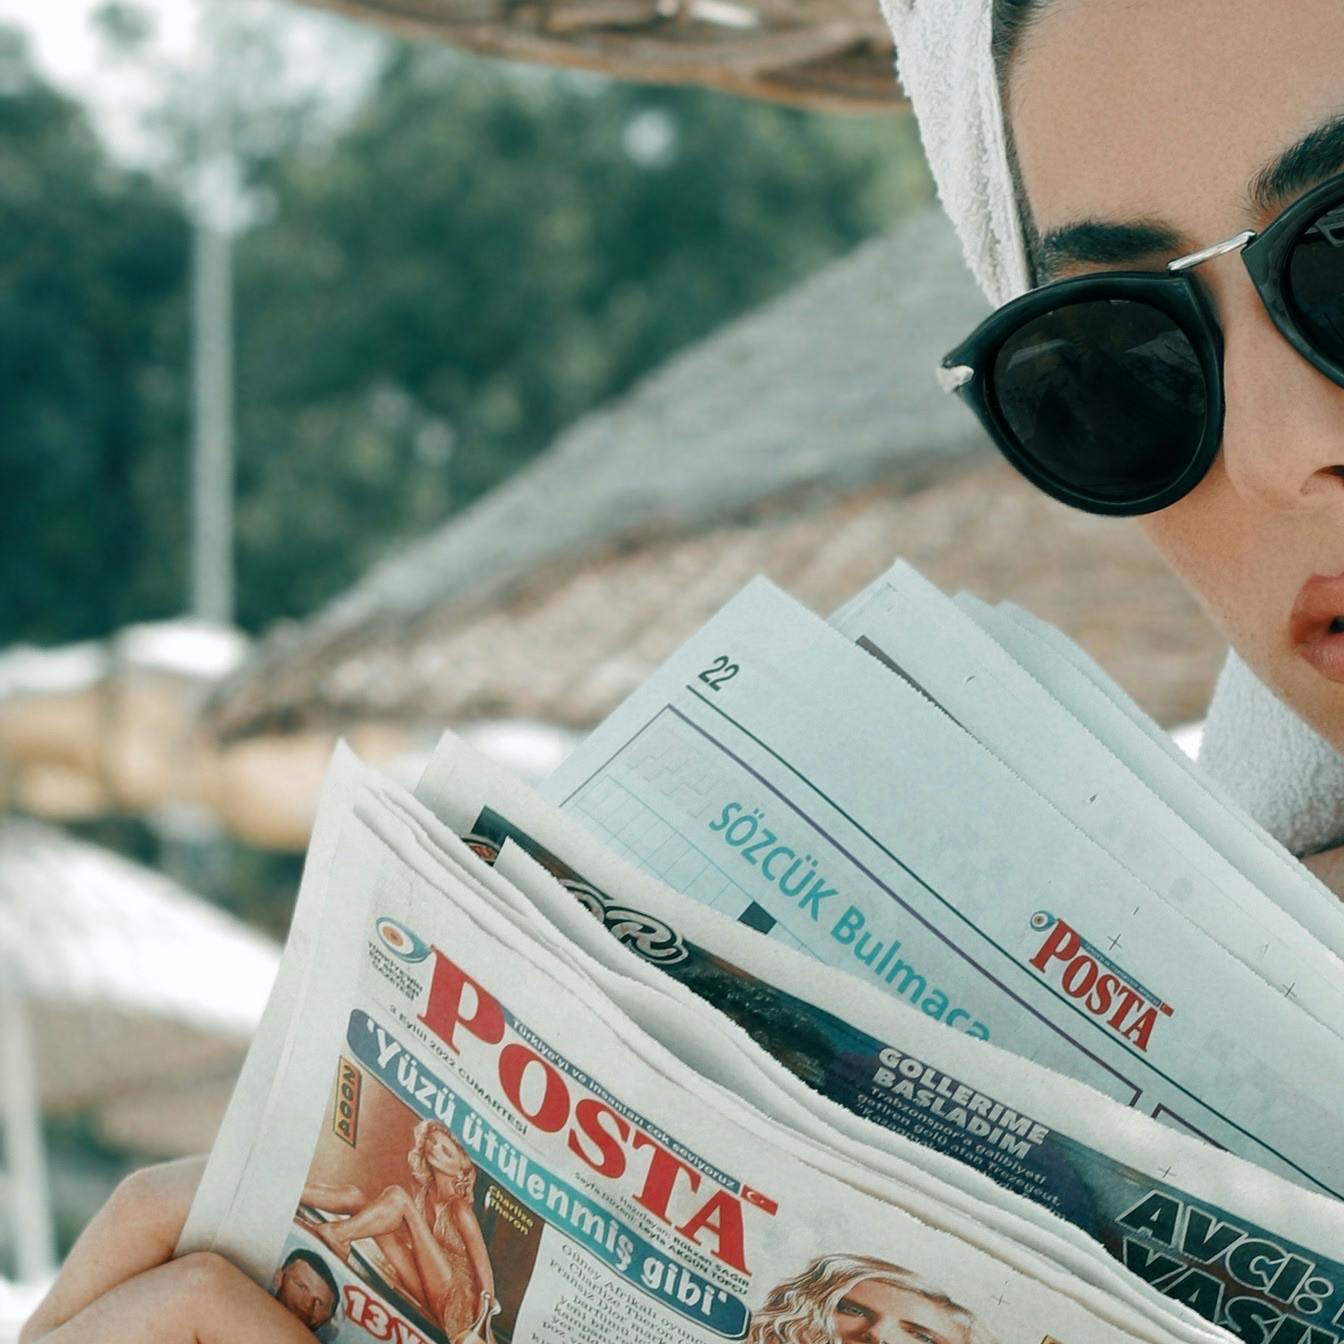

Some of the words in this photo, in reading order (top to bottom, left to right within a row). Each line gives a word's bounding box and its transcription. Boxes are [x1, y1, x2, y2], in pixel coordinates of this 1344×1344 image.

[696, 652, 741, 694] 22
[706, 797, 840, 923] SÖZCÜK
[1027, 917, 1170, 1053] POSTA
[414, 944, 754, 1276] POSTA
[463, 1113, 638, 1273] ütülenmiş
[1117, 1189, 1334, 1318] AVCI:
[347, 1288, 395, 1339] 13
